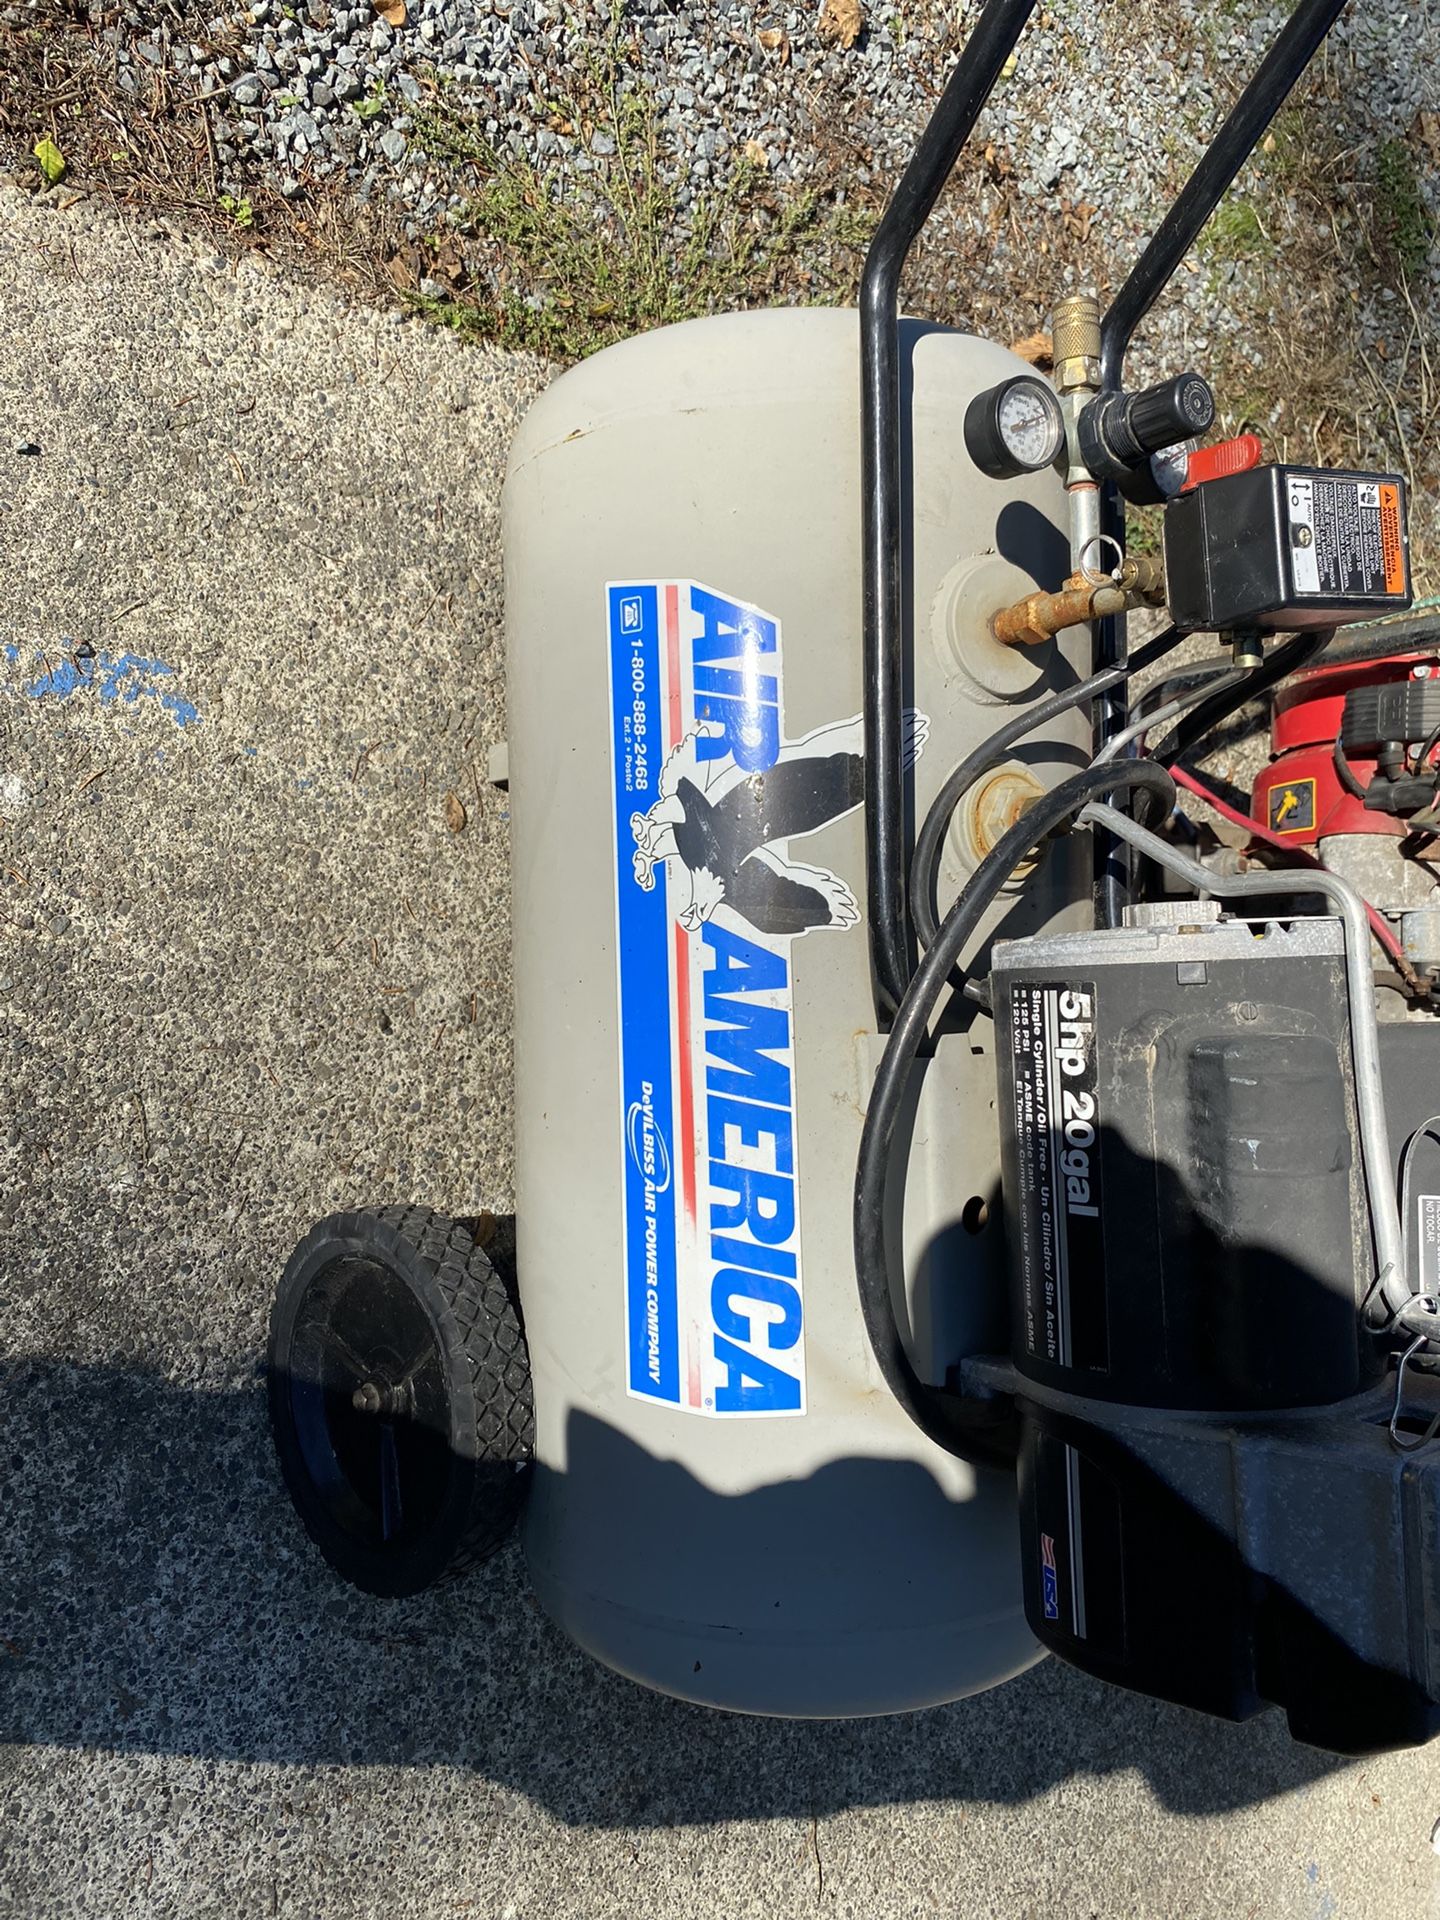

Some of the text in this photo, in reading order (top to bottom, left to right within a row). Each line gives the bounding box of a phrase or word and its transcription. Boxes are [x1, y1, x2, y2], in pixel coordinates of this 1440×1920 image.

[1383, 506, 1392, 585] AVERTISSEMENT
[1388, 506, 1396, 573] ADVERTENCIA
[631, 638, 648, 790] 1-800-888-2468
[625, 755, 633, 784] Poste
[691, 585, 803, 1412] AIR AMERICA
[1013, 1001, 1021, 1025] 120
[1031, 989, 1042, 1036] Single
[1016, 1081, 1023, 1096] El
[1021, 1001, 1036, 1191] 125 PSI ASME code tank
[1033, 1040, 1047, 1133] Cylinder/Oil
[1054, 990, 1099, 1217] 5hp 20gal
[1016, 1099, 1025, 1144] Tanque
[1018, 1149, 1028, 1199] Cumple
[1039, 1138, 1048, 1171] Free
[1021, 1204, 1029, 1228] con
[1041, 1186, 1049, 1206] Un
[641, 1081, 660, 1384] DeVILBISS AIR POWER COMPANY
[1425, 1201, 1435, 1243] NO TOCAR.
[1023, 1256, 1032, 1306] Normas
[1027, 1310, 1035, 1350] ASME
[1046, 1310, 1056, 1358] Aceite
[1043, 1565, 1058, 1619] USA
